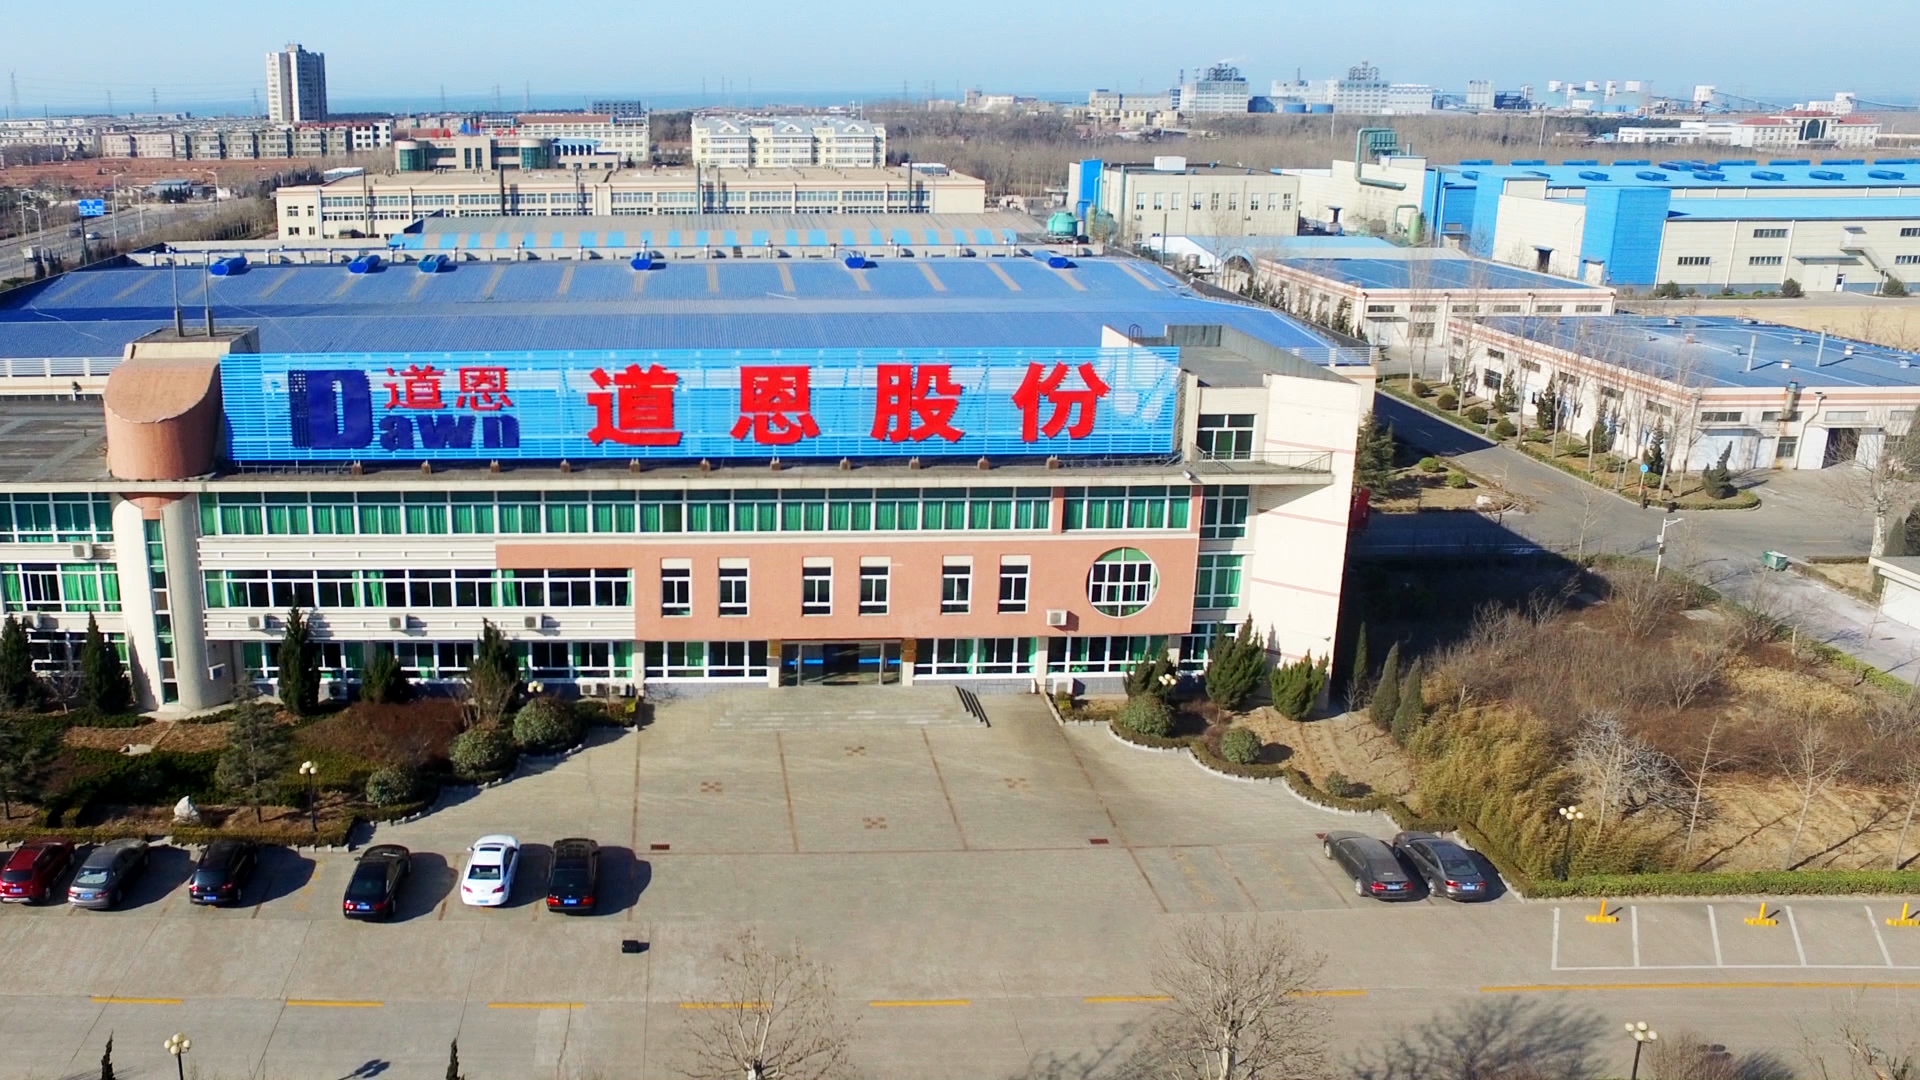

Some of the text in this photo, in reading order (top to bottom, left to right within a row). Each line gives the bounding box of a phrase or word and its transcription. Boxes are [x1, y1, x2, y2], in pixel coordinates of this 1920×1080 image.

[288, 369, 519, 450] Dawn
[384, 365, 512, 410] 道恩
[587, 363, 1109, 445] 道恩股份
